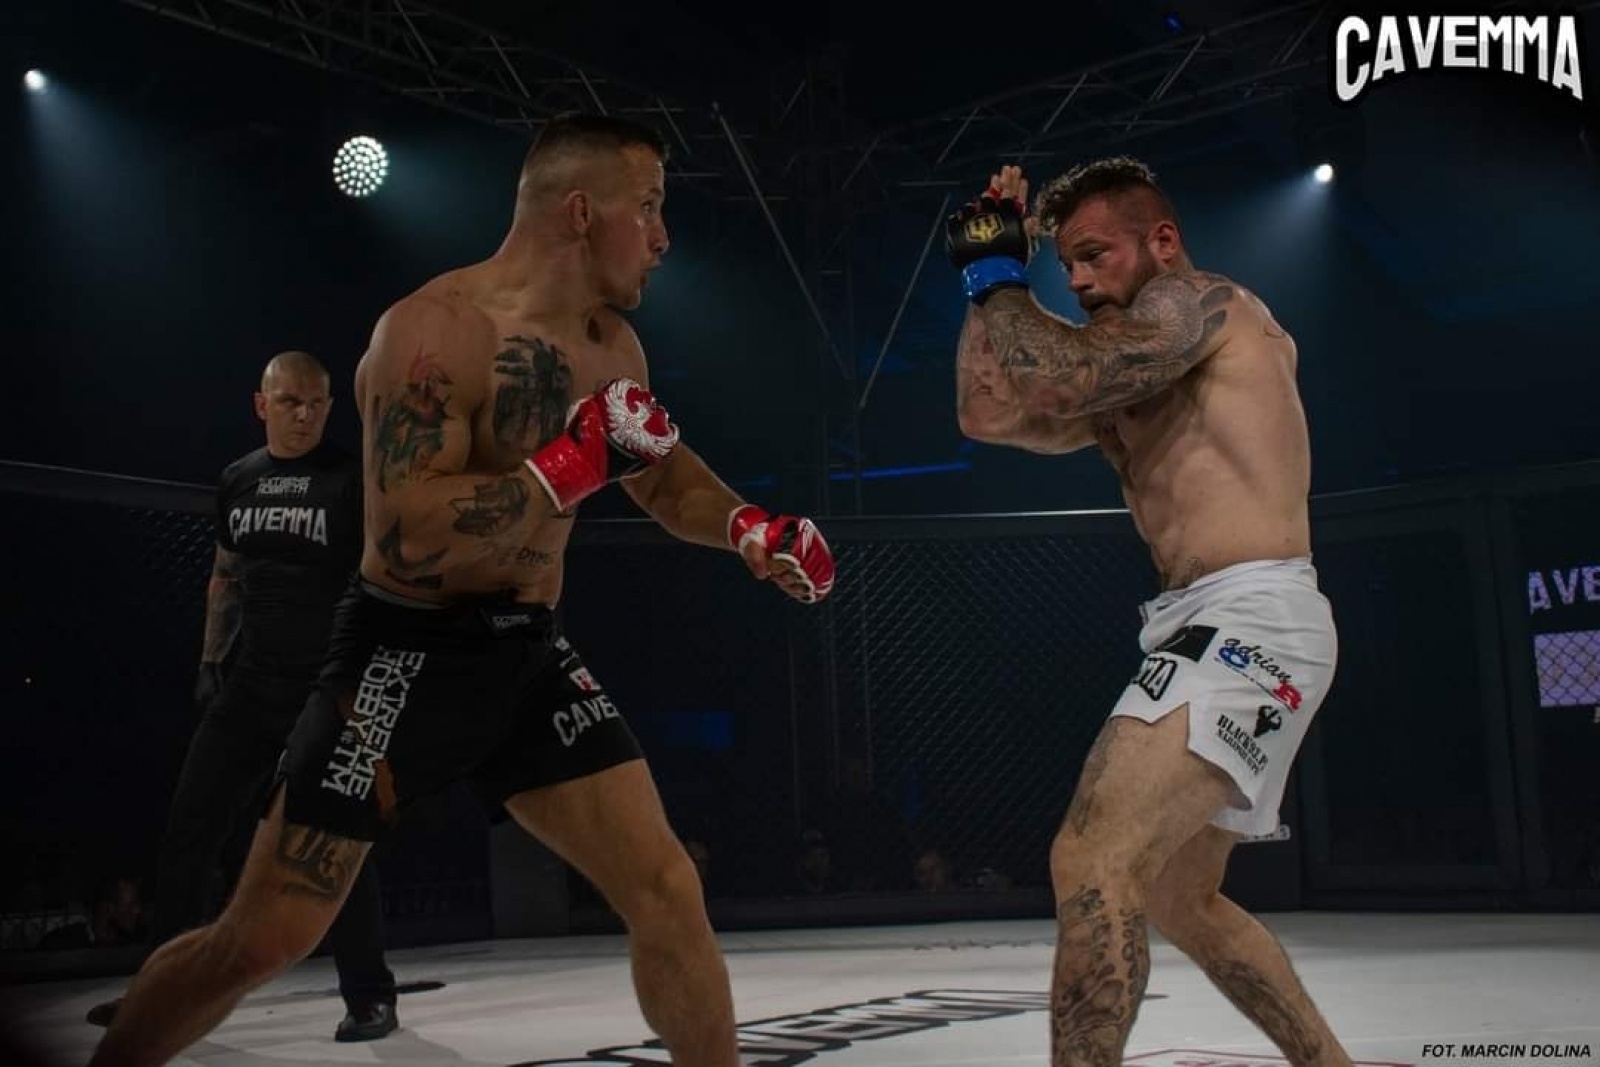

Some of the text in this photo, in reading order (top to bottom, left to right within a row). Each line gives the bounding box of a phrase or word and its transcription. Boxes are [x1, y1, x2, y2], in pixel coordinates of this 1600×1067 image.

[228, 506, 329, 547] CAVEMMA
[345, 645, 399, 739] HOBBY
[345, 650, 427, 802] EXTREME
